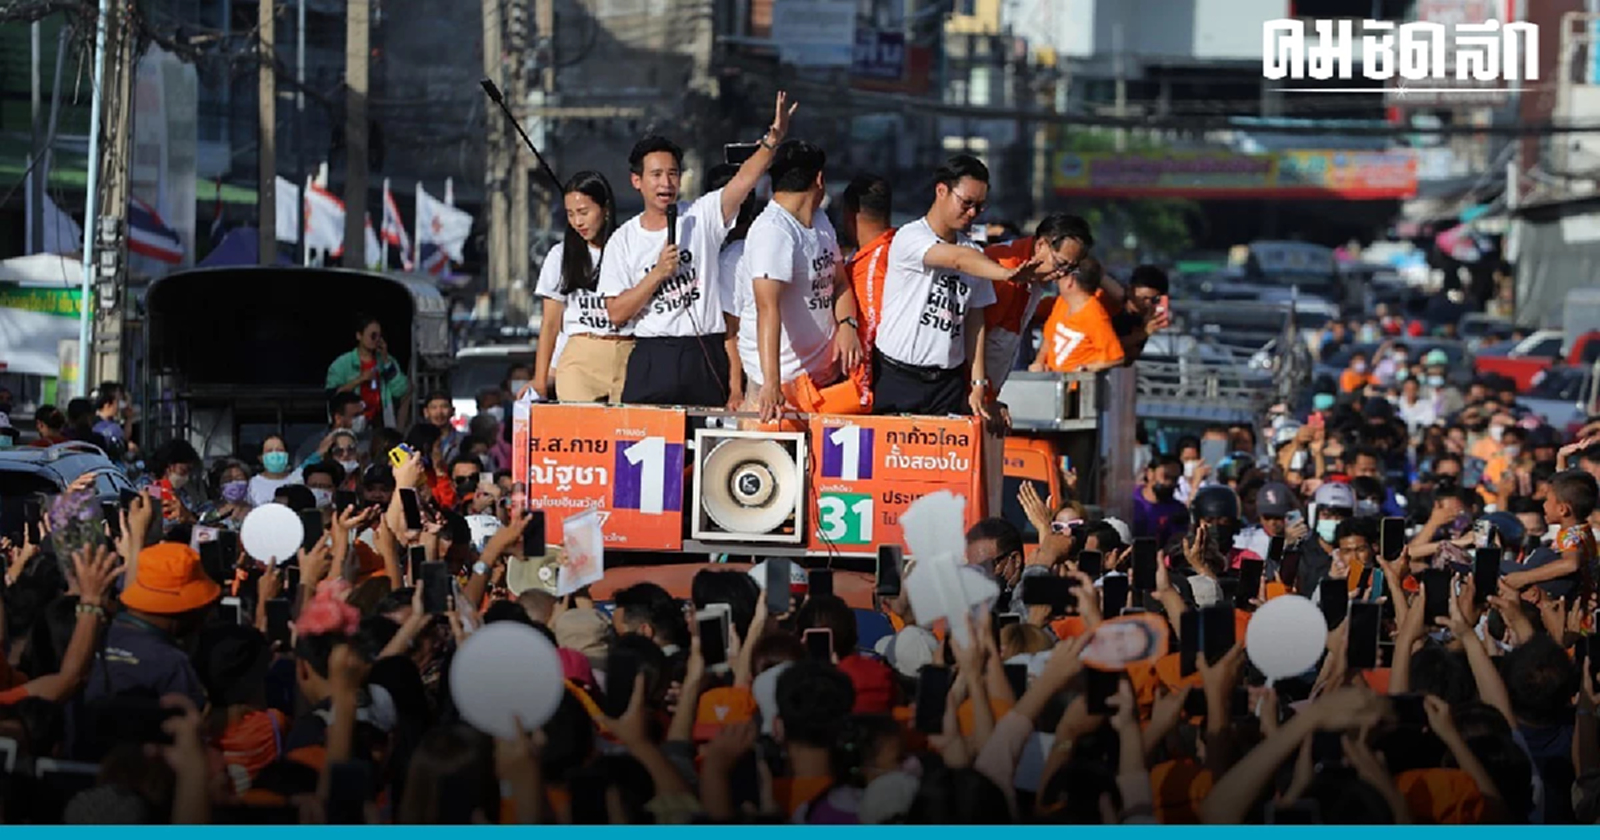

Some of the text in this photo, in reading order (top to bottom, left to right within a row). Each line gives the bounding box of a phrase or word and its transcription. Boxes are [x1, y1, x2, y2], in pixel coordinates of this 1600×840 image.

[829, 424, 860, 481] 1
[886, 427, 969, 447] กาก้าวไกล
[530, 457, 608, 492] ณัฐชา
[624, 436, 666, 514] 1
[885, 444, 969, 472] ทั้งสองใบ
[531, 495, 606, 508] ญไชยอินสวัสดิ์
[815, 496, 873, 542] 31
